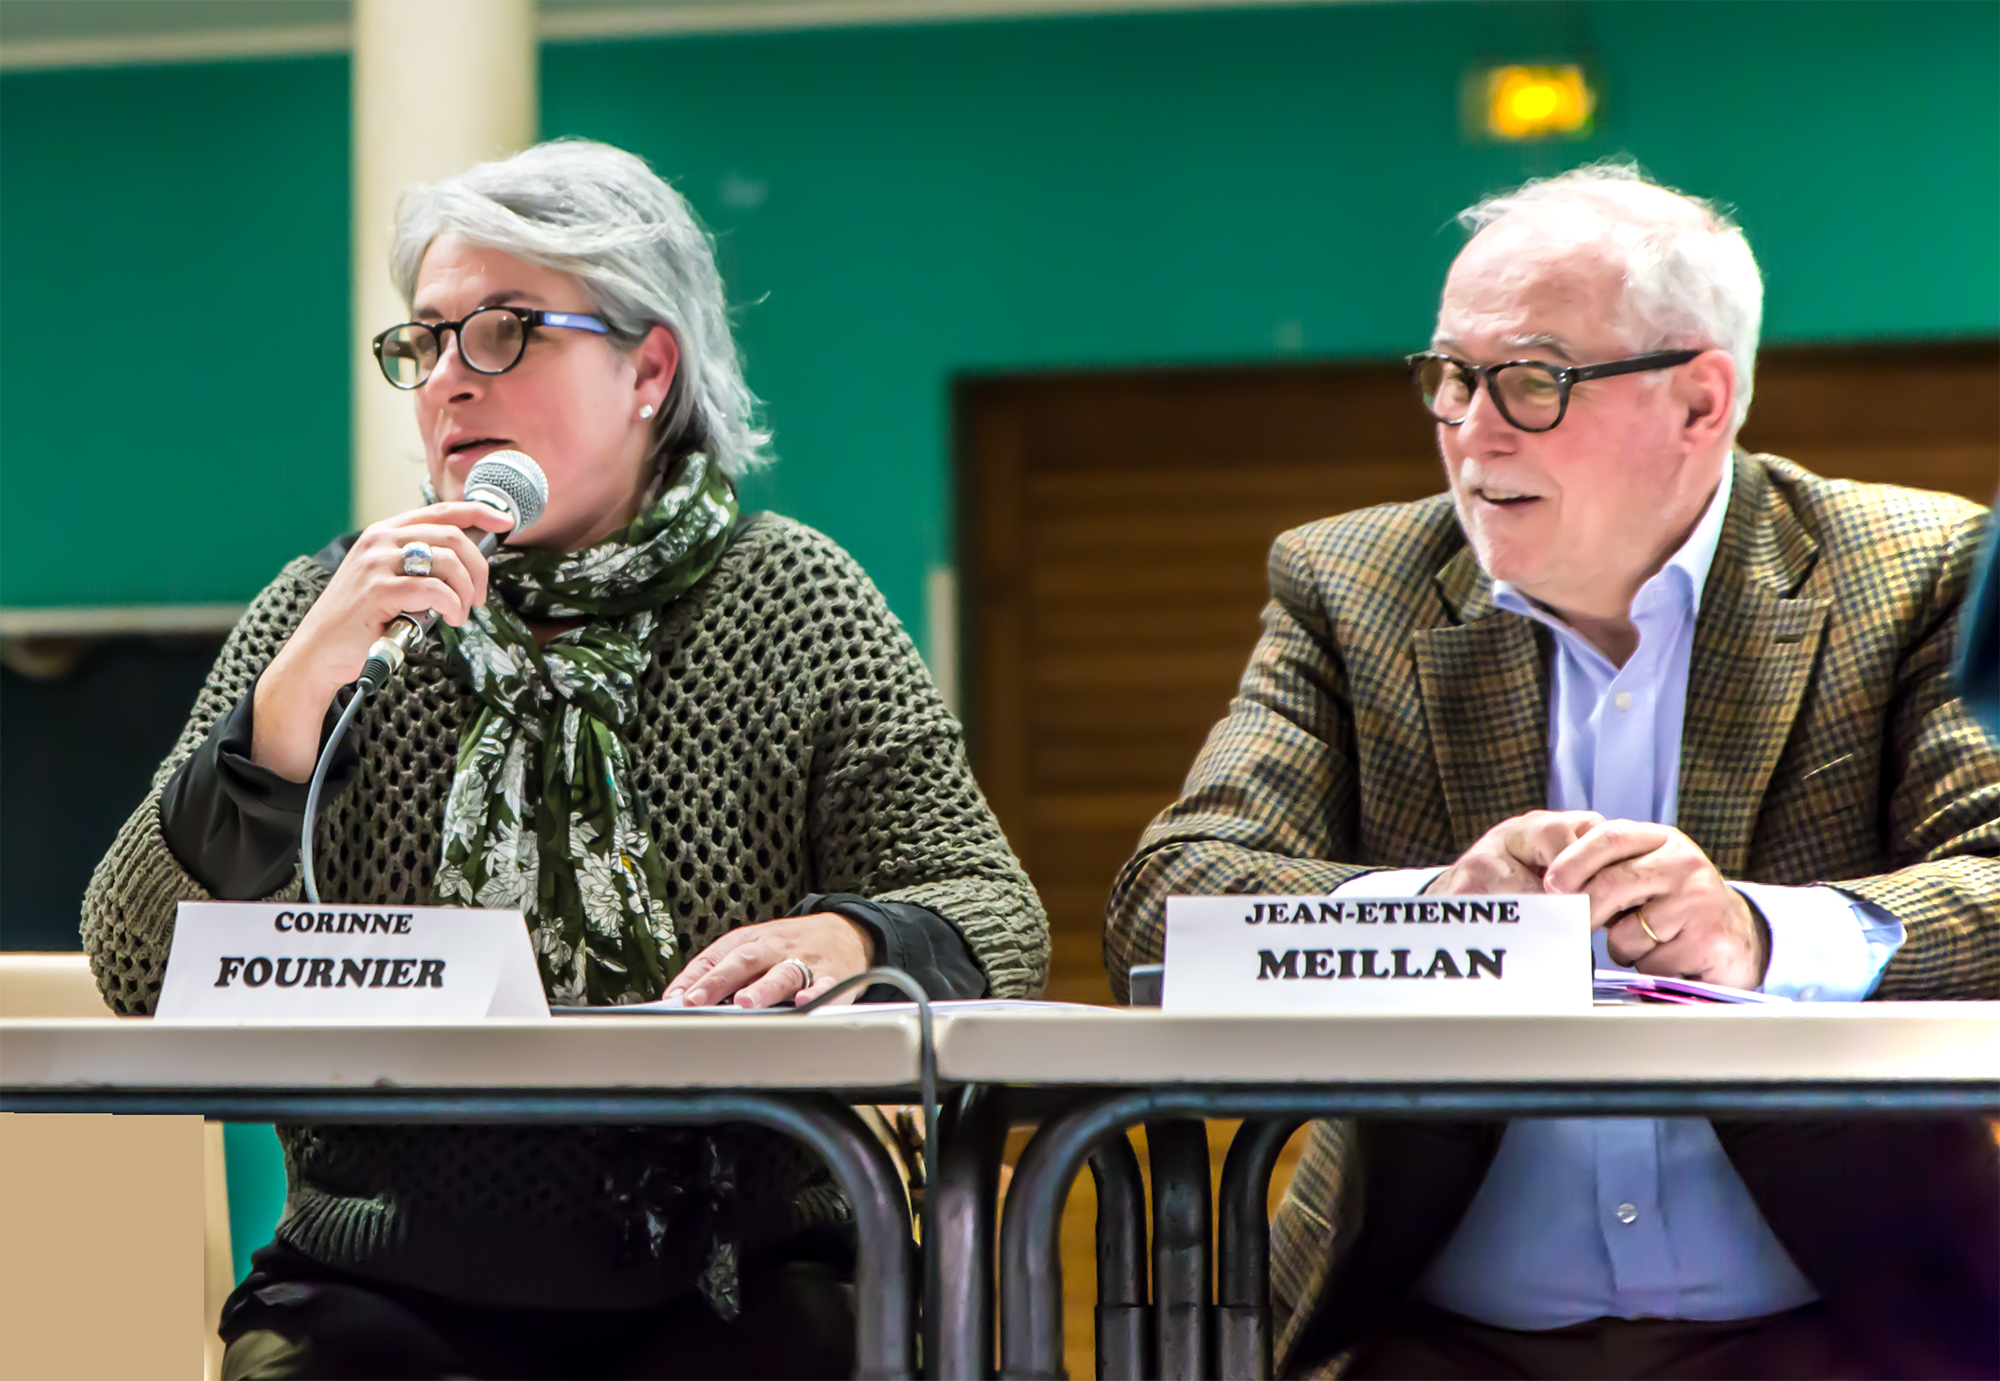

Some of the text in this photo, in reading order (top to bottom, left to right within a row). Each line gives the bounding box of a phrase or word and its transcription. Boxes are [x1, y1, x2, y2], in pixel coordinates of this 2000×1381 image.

[274, 911, 413, 935] CORINNE
[1244, 901, 1521, 925] JEAN-ETIENNE
[213, 956, 447, 989] FOURNIER
[1257, 948, 1507, 981] MEILLAN
